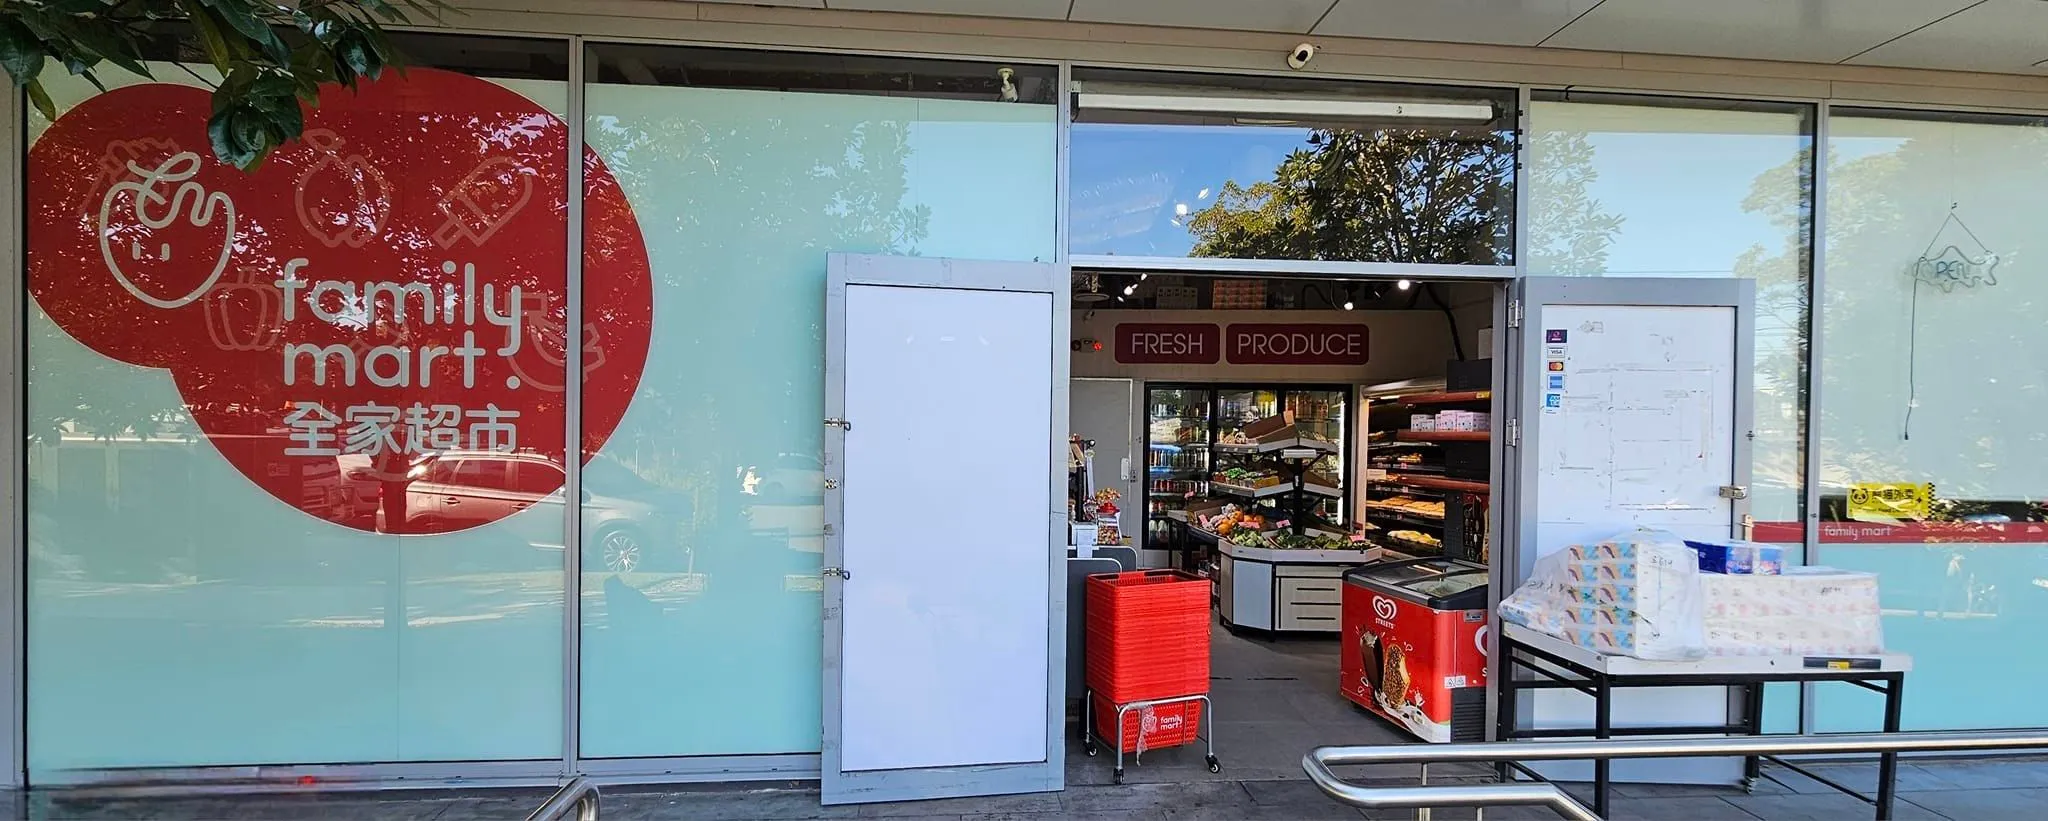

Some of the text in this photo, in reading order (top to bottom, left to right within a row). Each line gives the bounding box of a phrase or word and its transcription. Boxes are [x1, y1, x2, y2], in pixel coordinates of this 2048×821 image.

[274, 258, 522, 357] family
[1132, 333, 1361, 355] FRESH PRODUCE
[283, 401, 520, 457] 全家超市
[1824, 525, 1892, 540] family mart
[1161, 715, 1183, 725] family
